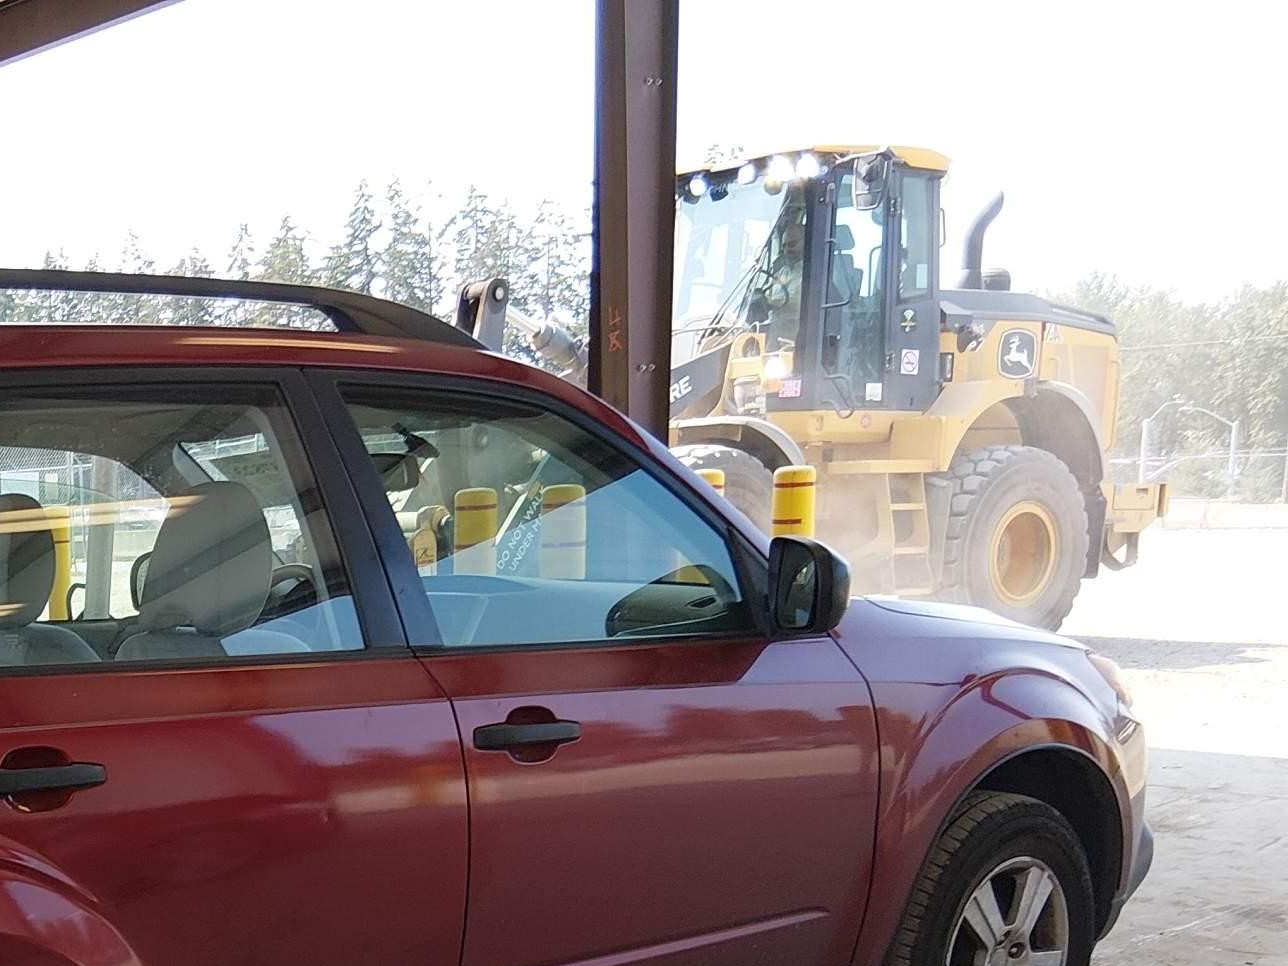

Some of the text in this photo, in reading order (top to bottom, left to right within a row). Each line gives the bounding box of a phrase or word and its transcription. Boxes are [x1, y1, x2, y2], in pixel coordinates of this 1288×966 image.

[496, 550, 510, 569] DO
[508, 522, 526, 549] NOT
[508, 532, 534, 571] UNDER
